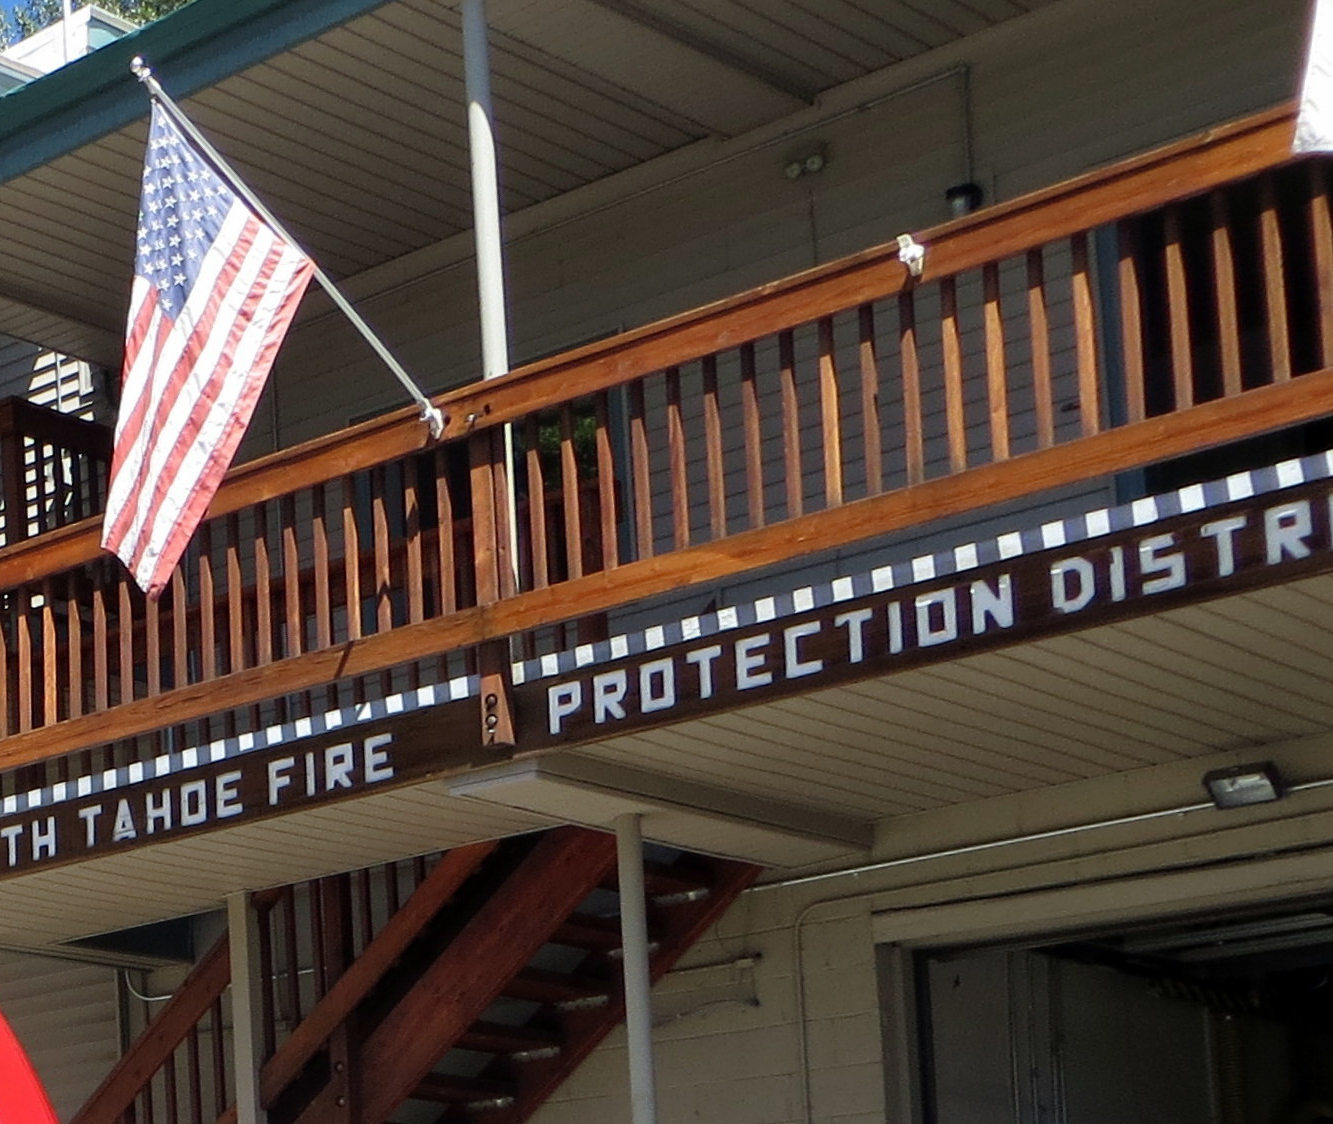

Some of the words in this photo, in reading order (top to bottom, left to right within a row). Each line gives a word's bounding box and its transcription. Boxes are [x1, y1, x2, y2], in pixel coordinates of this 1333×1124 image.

[547, 574, 1014, 735] PROTECTION
[78, 770, 244, 848] TAHOE
[267, 733, 395, 806] FIRE
